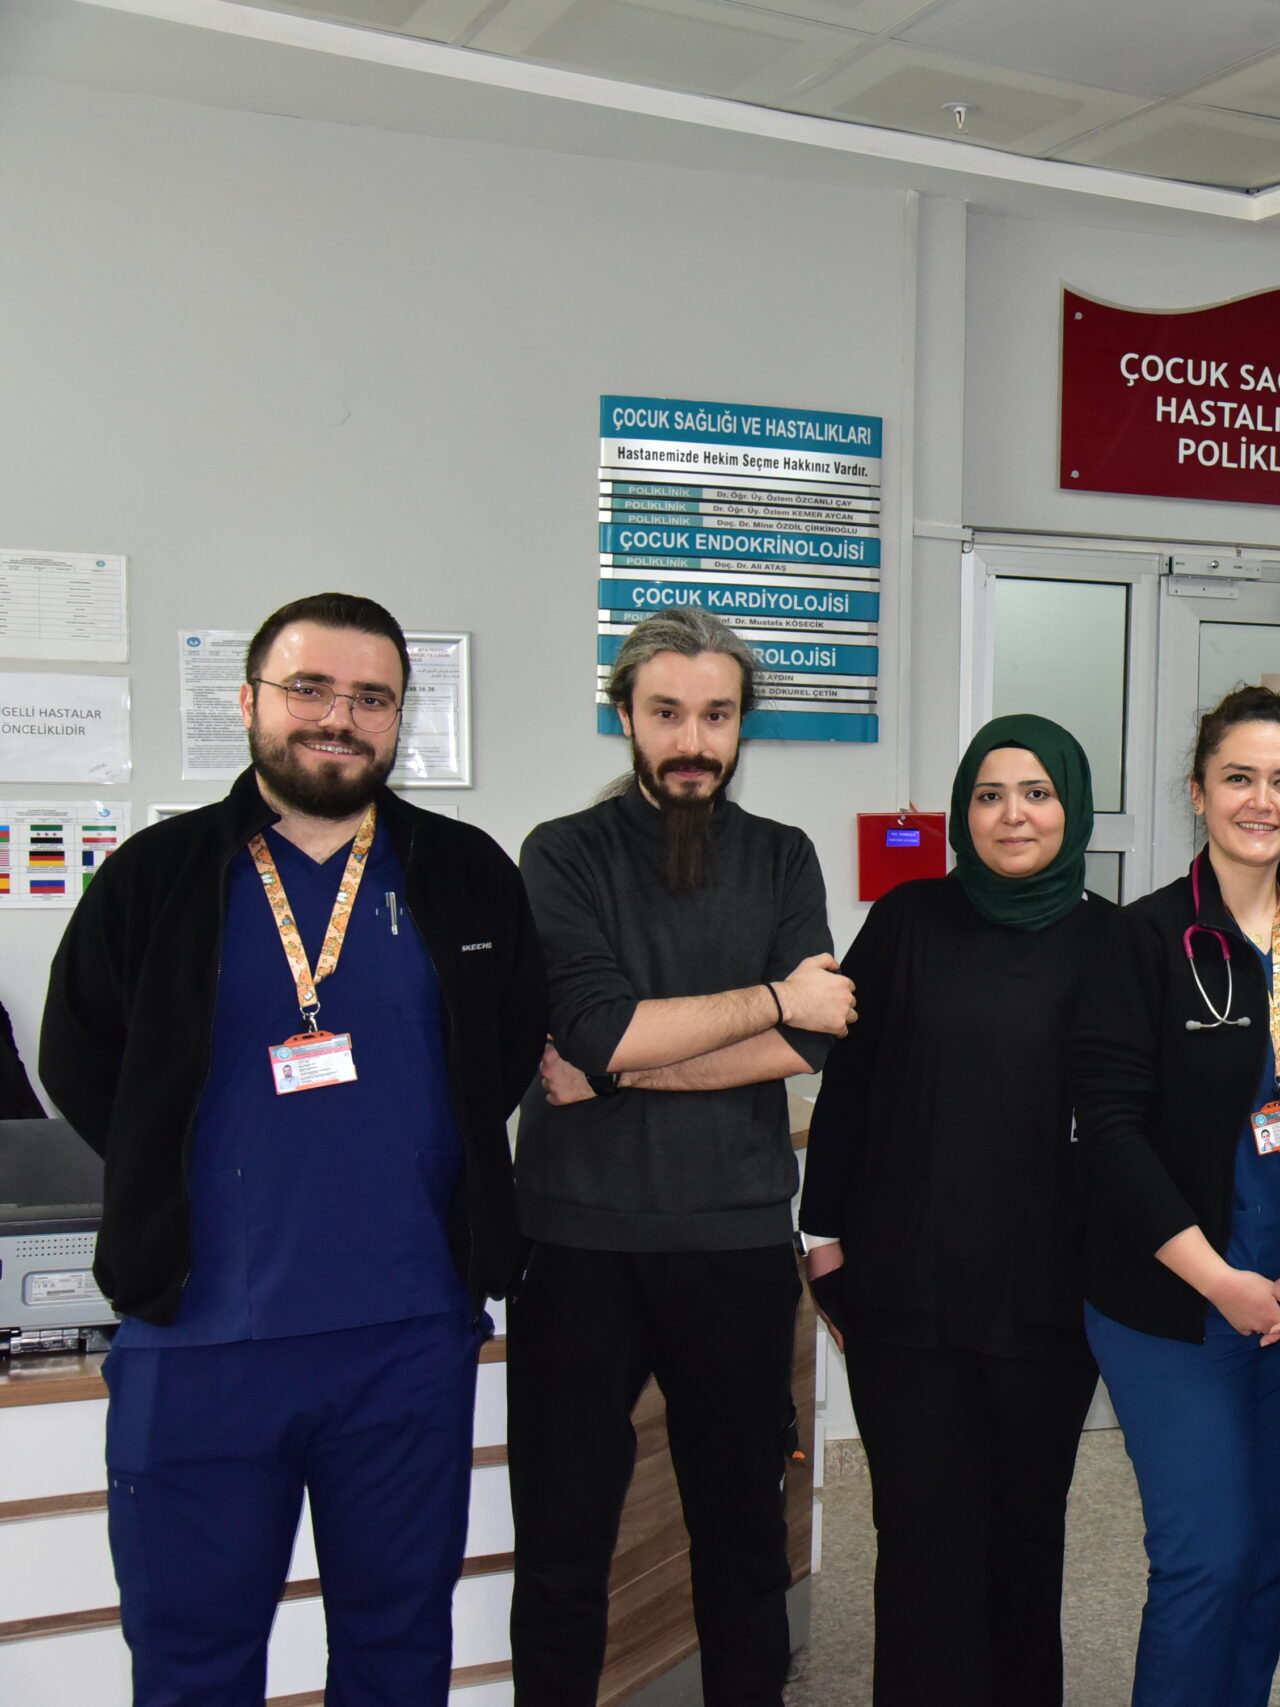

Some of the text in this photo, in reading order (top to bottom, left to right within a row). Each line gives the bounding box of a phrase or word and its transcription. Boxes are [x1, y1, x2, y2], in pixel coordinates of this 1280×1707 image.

[1120, 352, 1229, 389] ÇOCUK
[613, 407, 871, 445] ÇOCUK SAĞLIĞI VE HASTALIKLARI
[617, 446, 868, 477] Hastanemizde Hekim Seçme Hakkınız Vardır.
[628, 486, 691, 497] POLİKLİNİK
[624, 500, 687, 511] POLİKLİNİK
[628, 514, 691, 525] POLİKLİNİK
[792, 510, 822, 518] KEMER
[825, 512, 854, 520] AYCAN
[619, 531, 865, 560] ÇOCUK ENDOKRİNOLOJİSİ
[626, 557, 688, 567] POLİKLİNİK
[632, 587, 850, 613] ÇOCUK KARDİYOLOJİSİ
[749, 618, 783, 627] Mustafa
[752, 646, 836, 667] ROLOJİSİ
[0, 705, 102, 719] GELLİ HASTALAR
[1, 721, 86, 736] ÖNCELİKLİDİR
